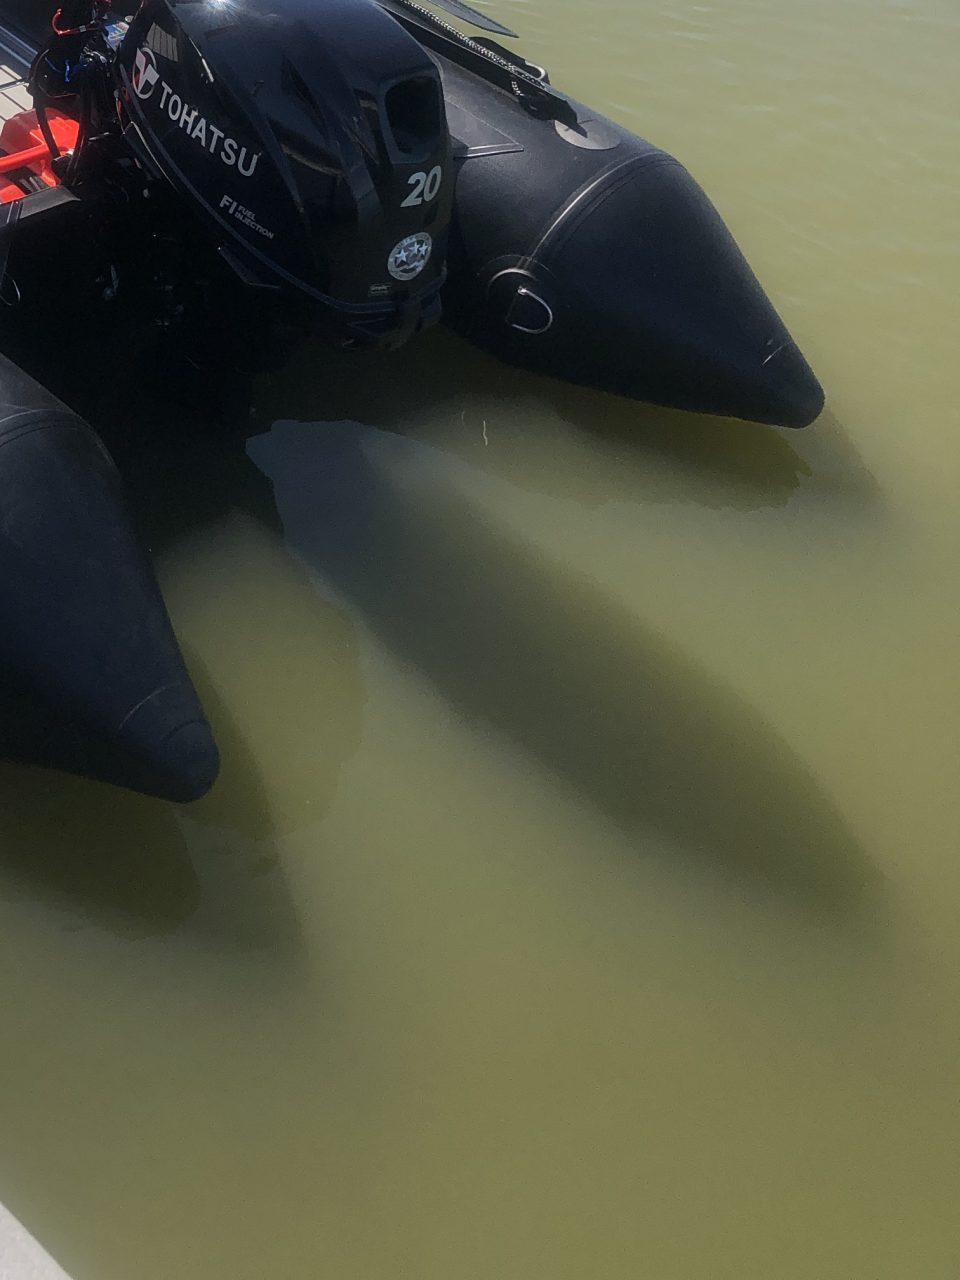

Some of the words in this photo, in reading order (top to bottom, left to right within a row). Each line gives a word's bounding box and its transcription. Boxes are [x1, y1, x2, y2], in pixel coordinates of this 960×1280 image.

[157, 80, 260, 177] TOHATSU
[400, 166, 441, 208] 20
[219, 194, 238, 214] FI
[238, 205, 256, 221] FUEL
[234, 211, 274, 239] INJECTION
